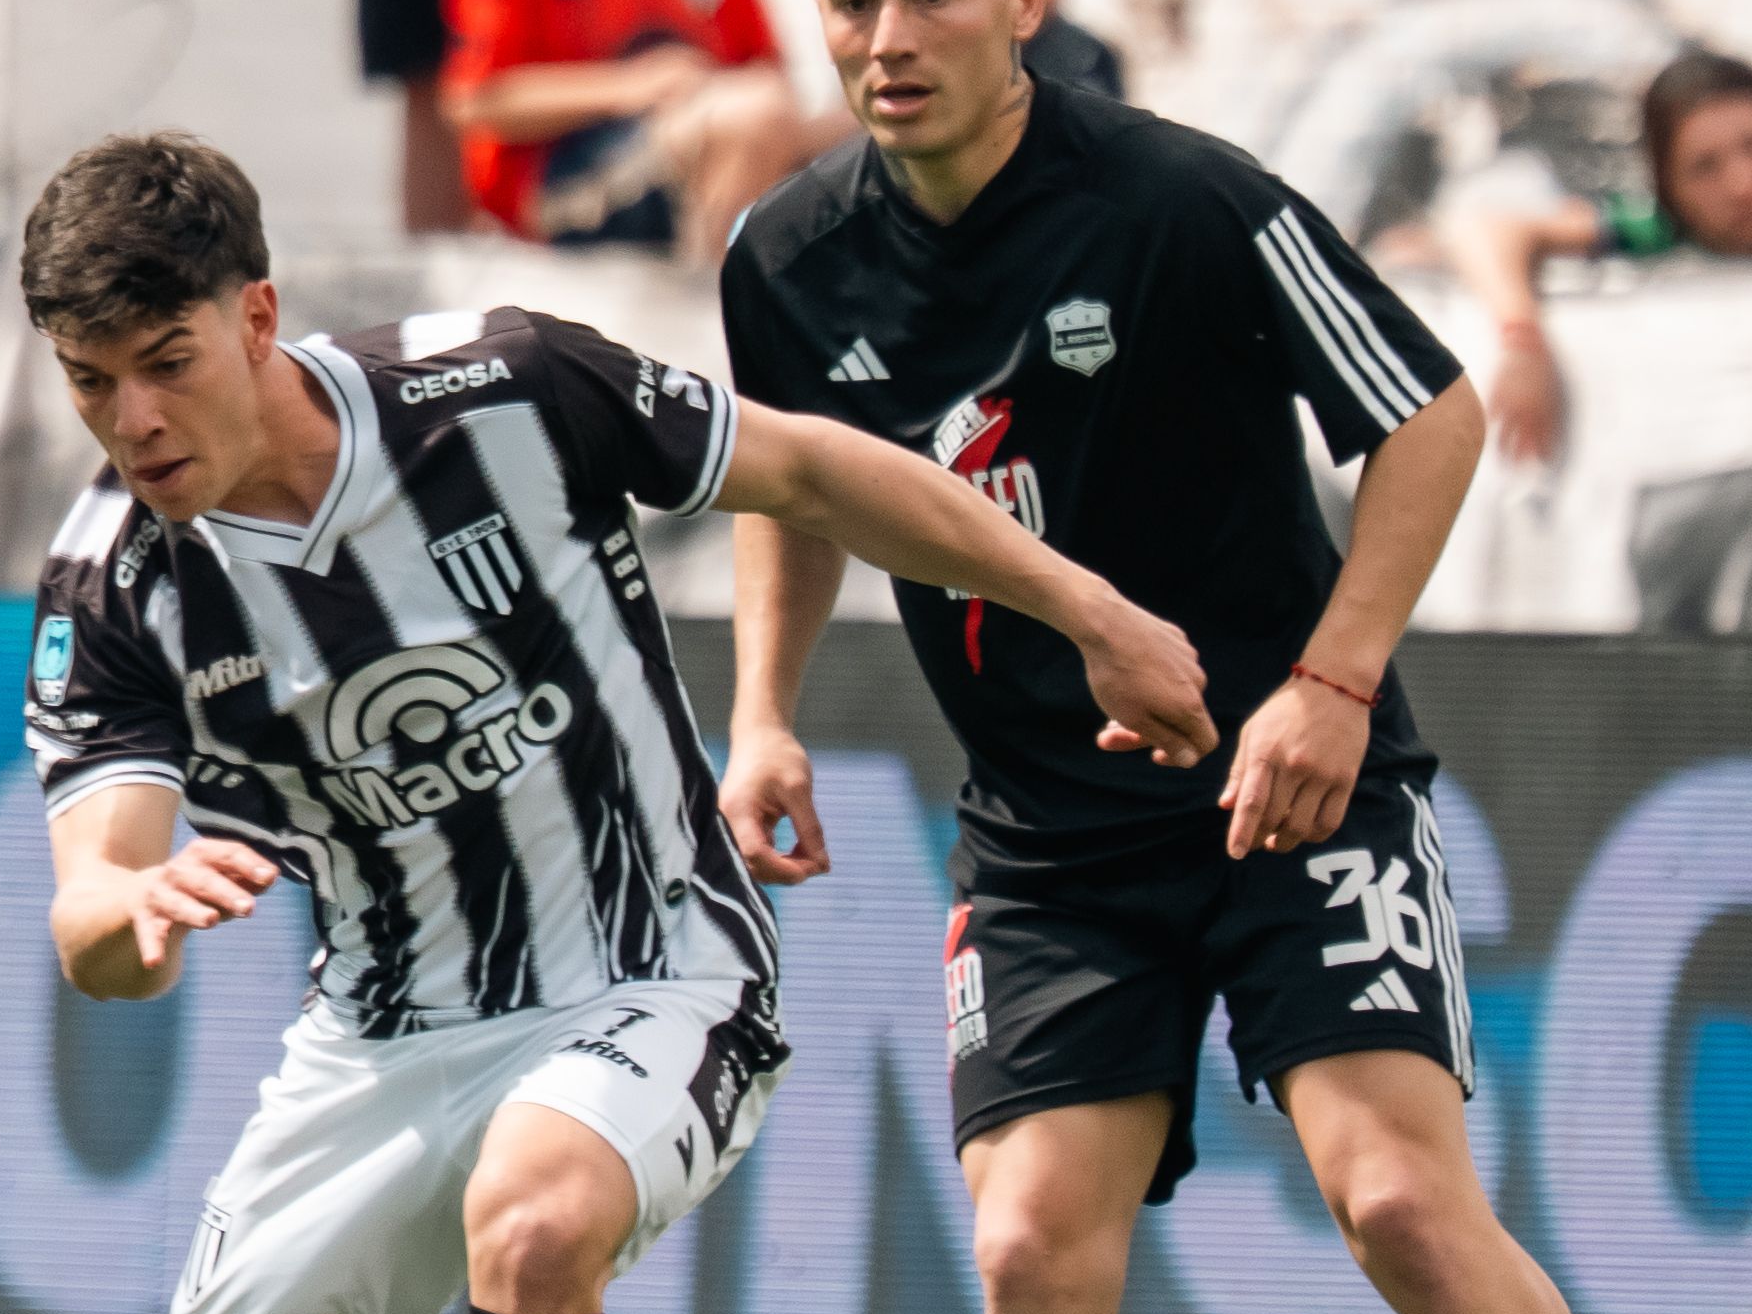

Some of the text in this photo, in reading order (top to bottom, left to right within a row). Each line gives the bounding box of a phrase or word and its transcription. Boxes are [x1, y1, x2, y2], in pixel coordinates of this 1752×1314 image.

[399, 357, 514, 406] CEOSA
[114, 517, 162, 589] CEOS
[318, 682, 574, 828] Macro
[1305, 847, 1434, 970] 36
